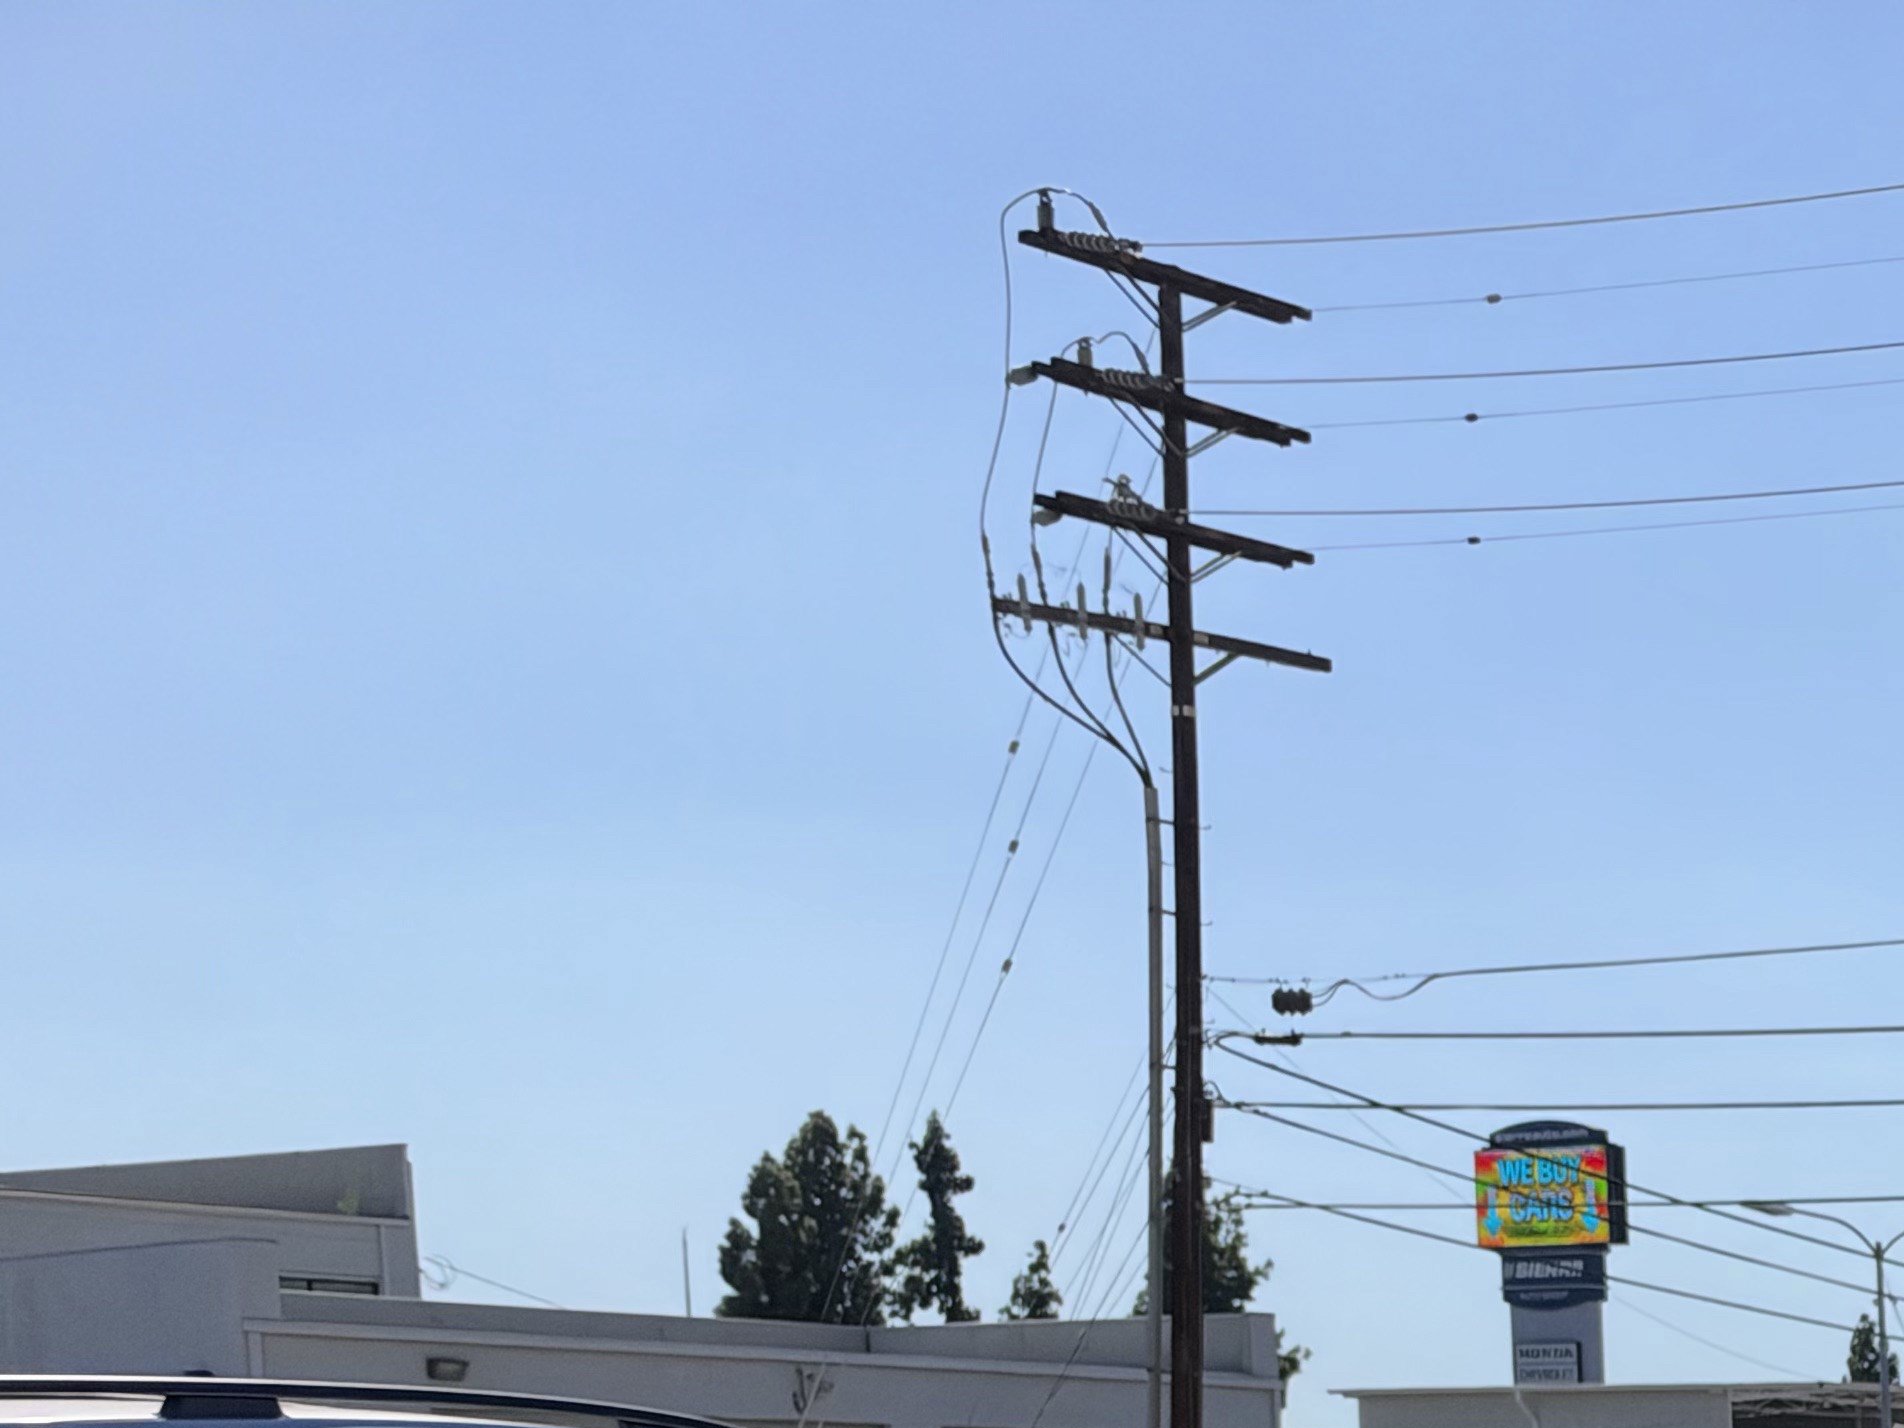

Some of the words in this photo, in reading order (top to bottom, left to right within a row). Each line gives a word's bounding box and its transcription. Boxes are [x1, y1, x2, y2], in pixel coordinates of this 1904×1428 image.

[1497, 1156, 1534, 1186] WE
[1536, 1154, 1581, 1184] BUY
[1509, 1187, 1574, 1222] CARS
[1518, 1347, 1574, 1359] HONDA
